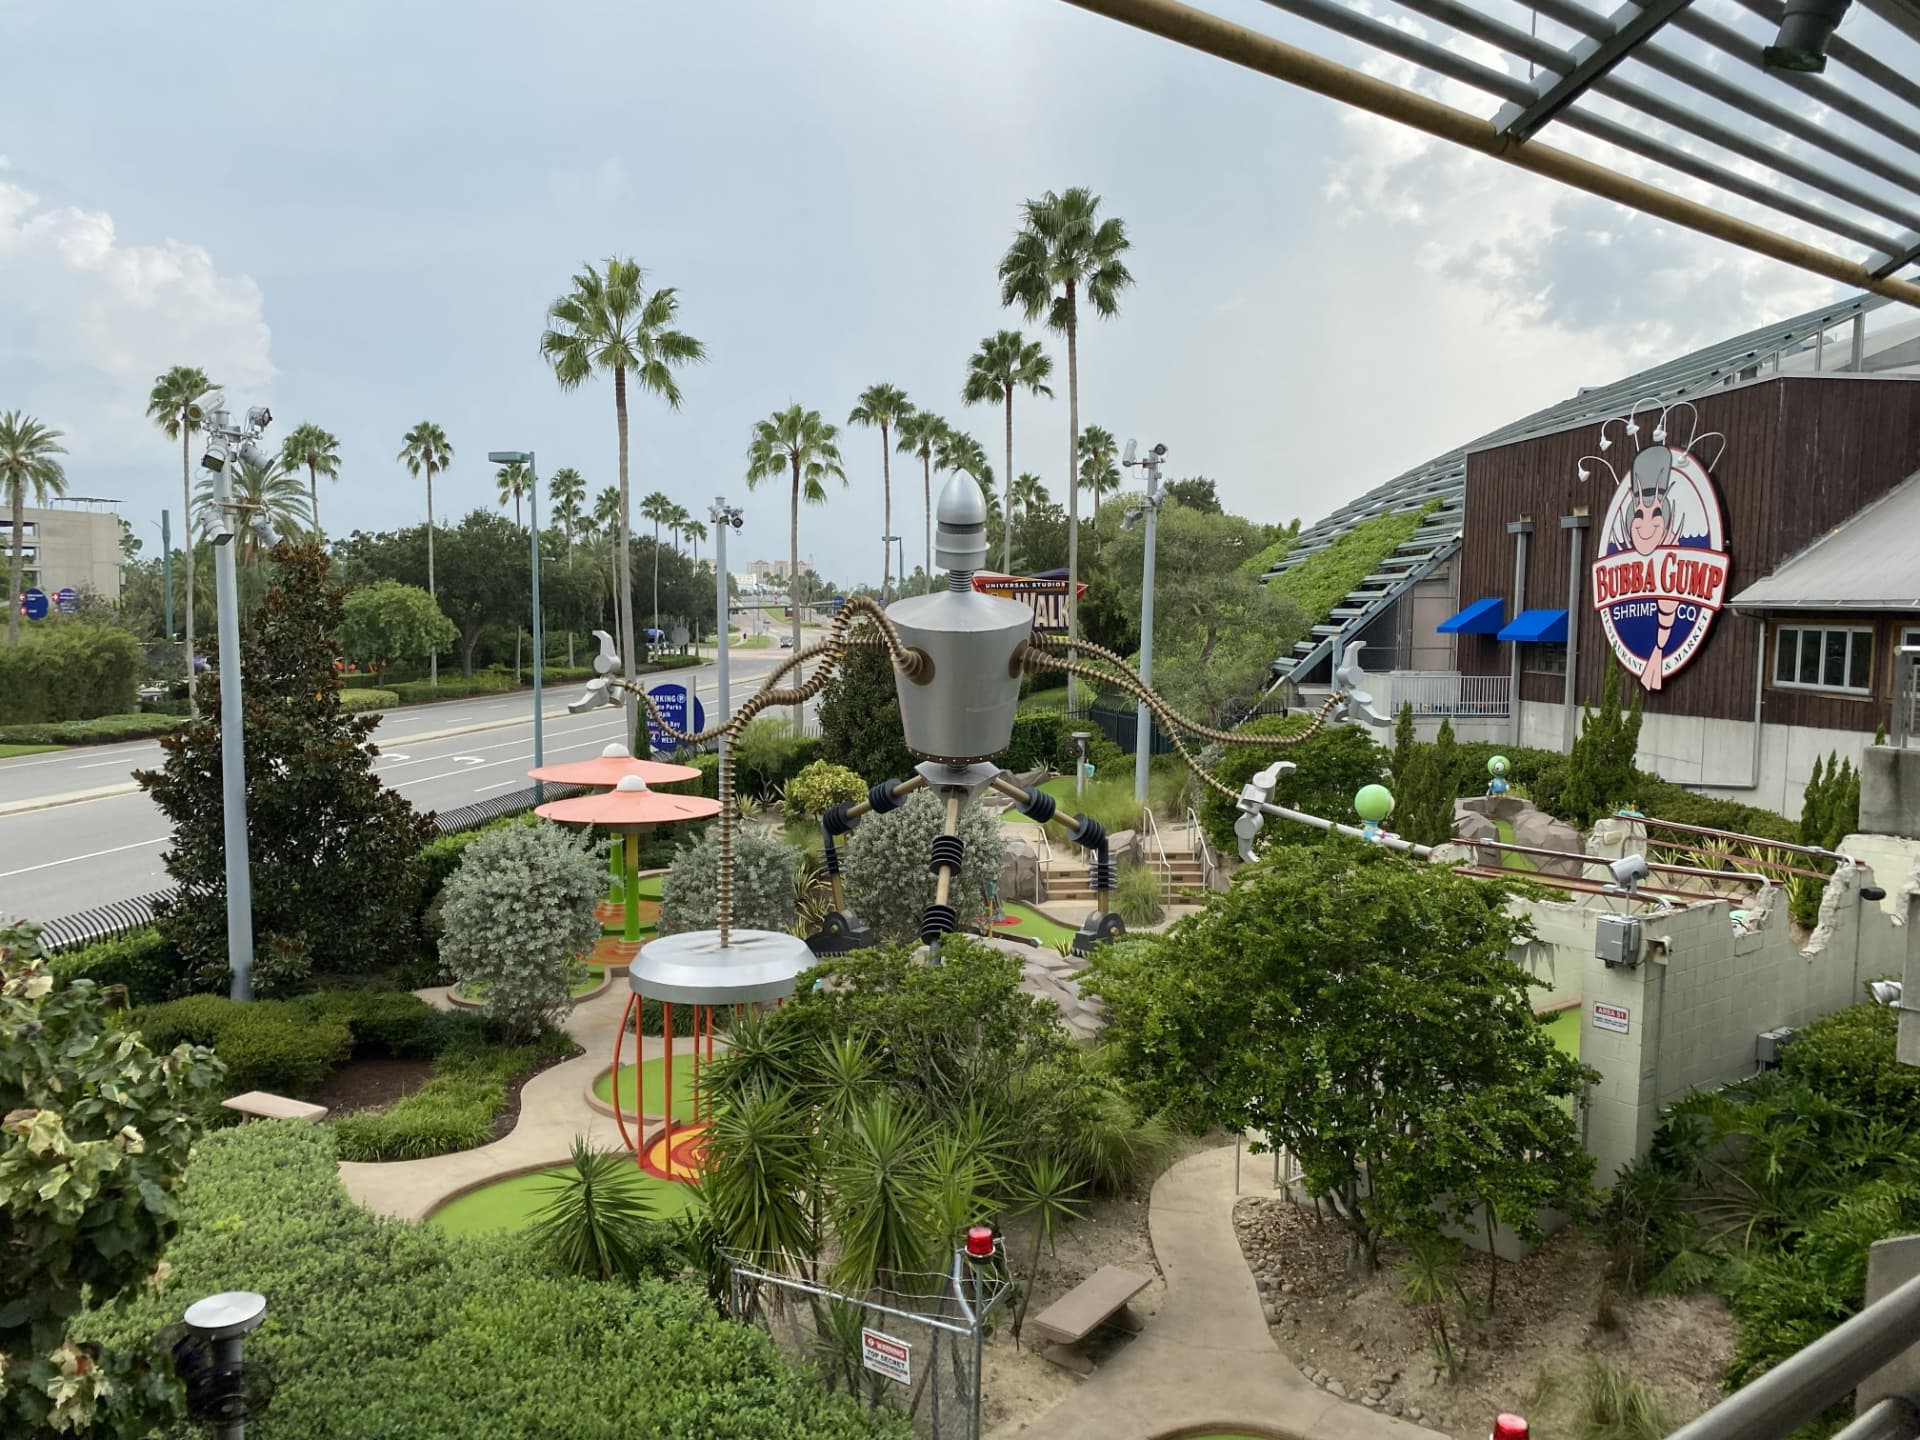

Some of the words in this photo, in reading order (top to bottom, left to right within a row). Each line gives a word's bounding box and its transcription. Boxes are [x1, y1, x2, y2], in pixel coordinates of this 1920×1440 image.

[1596, 559, 1657, 603] BUBBA
[1660, 552, 1723, 600] GUMP
[1613, 603, 1657, 620] SHRIMP
[1602, 609, 1643, 671] RESTAURANT
[1664, 662, 1672, 671] &
[1674, 611, 1708, 665] MARKET
[650, 695, 677, 703] ARKING
[867, 1349, 879, 1358] TOP
[880, 1354, 905, 1369] SECRET
